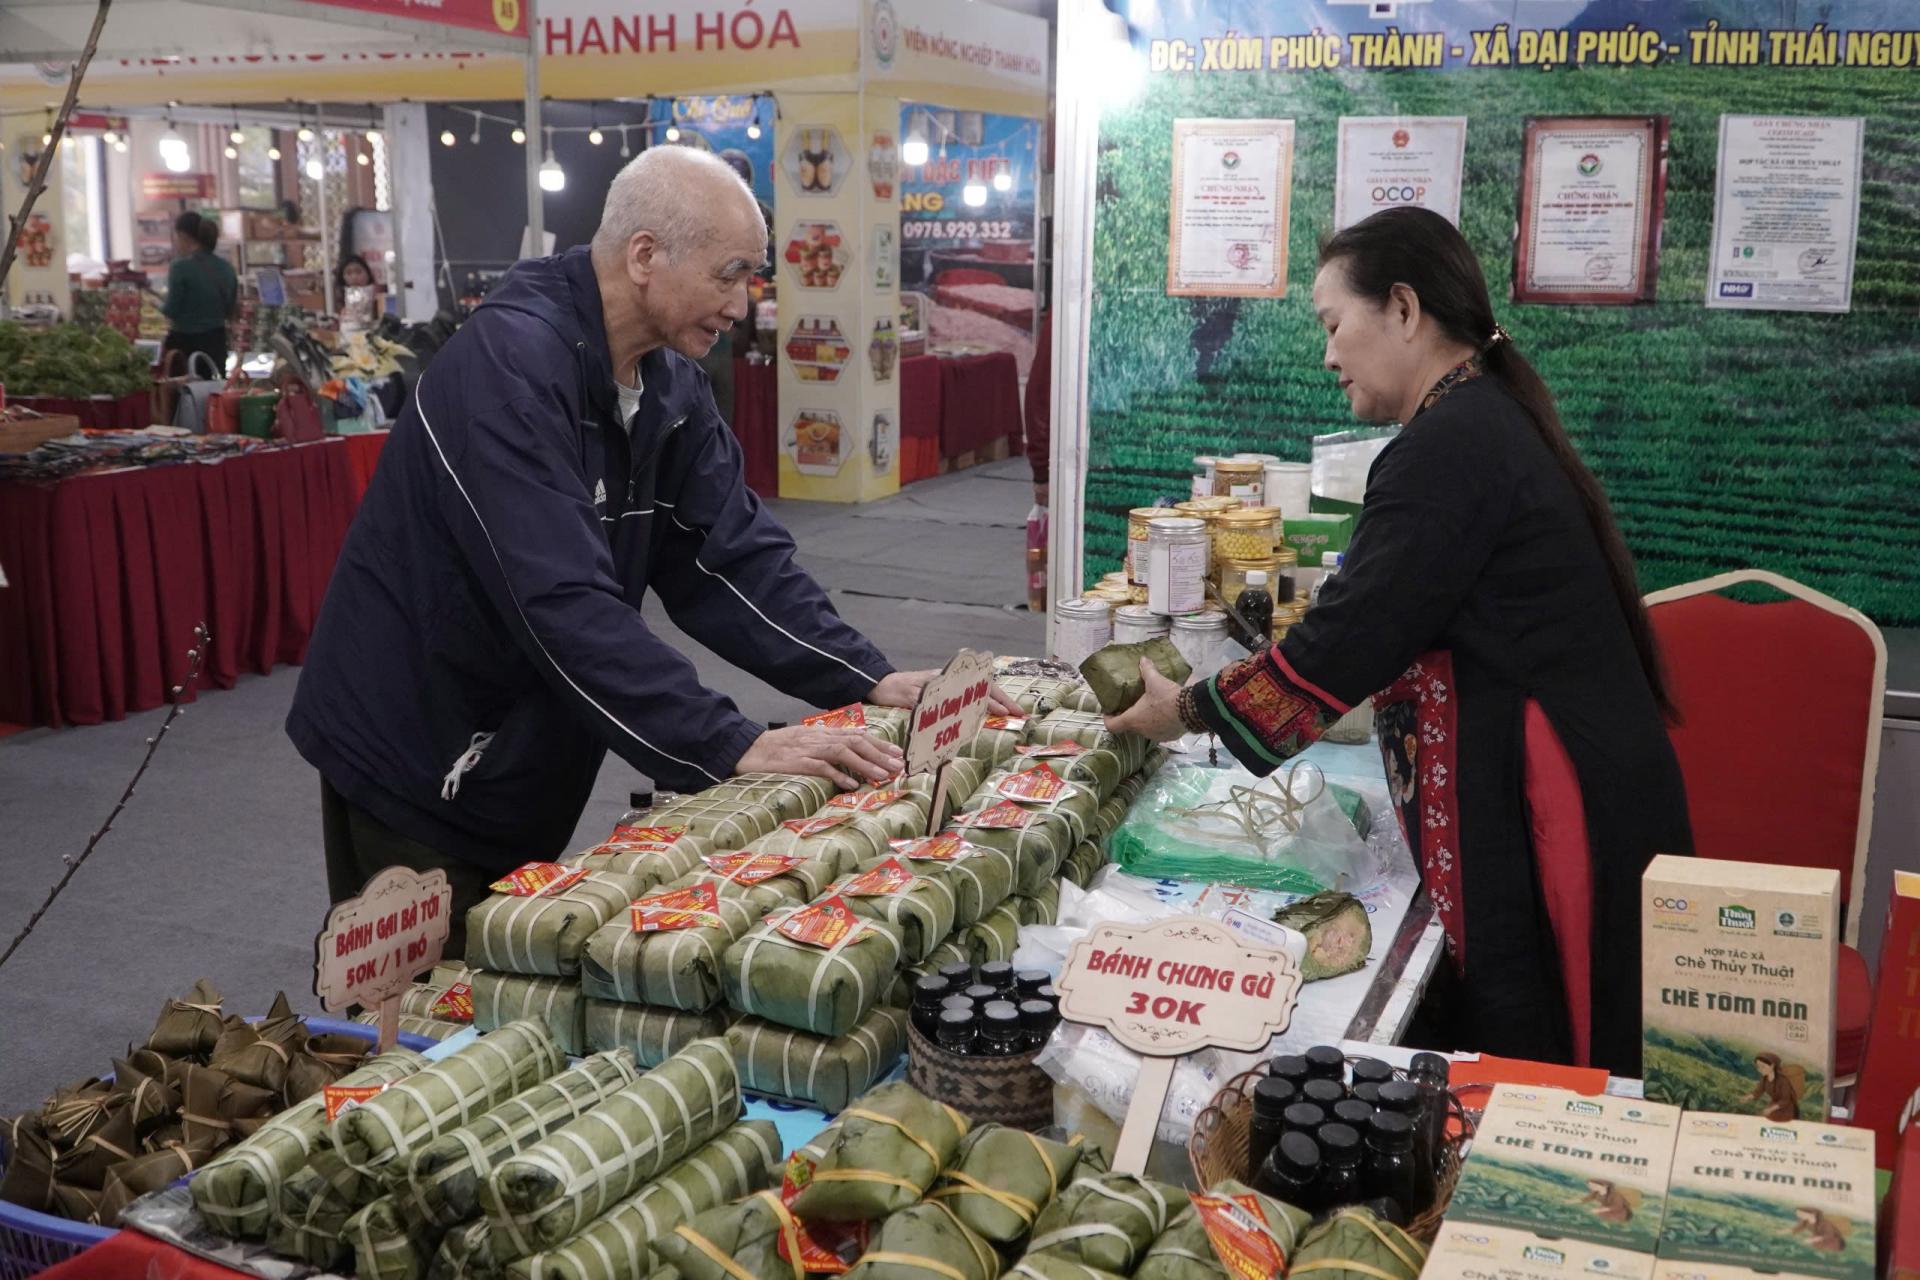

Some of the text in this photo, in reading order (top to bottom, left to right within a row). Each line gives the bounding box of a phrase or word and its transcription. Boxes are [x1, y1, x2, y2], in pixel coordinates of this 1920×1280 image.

[537, 0, 801, 55] HANH HÓA
[1150, 38, 1196, 72] ĐC:
[1200, 31, 1264, 71] XÓM
[1270, 28, 1341, 70] PHÚC
[1348, 26, 1444, 69] THÀNH
[1469, 24, 1511, 66] XÃ
[1517, 29, 1569, 72] ĐẠI
[1576, 24, 1660, 65] PHÚC
[1689, 19, 1761, 66] TỈNH
[1768, 23, 1839, 66] THÁI
[900, 192, 944, 212] NG
[1372, 186, 1426, 201] OCOP
[903, 221, 1011, 239] 0978.929.332
[933, 720, 962, 752] 50K
[336, 923, 373, 957] BÁNH
[401, 901, 418, 932] BÀ
[420, 892, 439, 922] TỚI
[346, 958, 377, 989] 50K
[395, 947, 401, 968] 1
[1675, 955, 1794, 981] Chè Thủy Thuật
[1704, 947, 1765, 961] HỢP TÁC XÃ
[1087, 947, 1153, 979] BÁNH
[1240, 971, 1275, 999] GÙ
[1125, 991, 1207, 1025] 30K
[1662, 987, 1699, 1008] CHÈ
